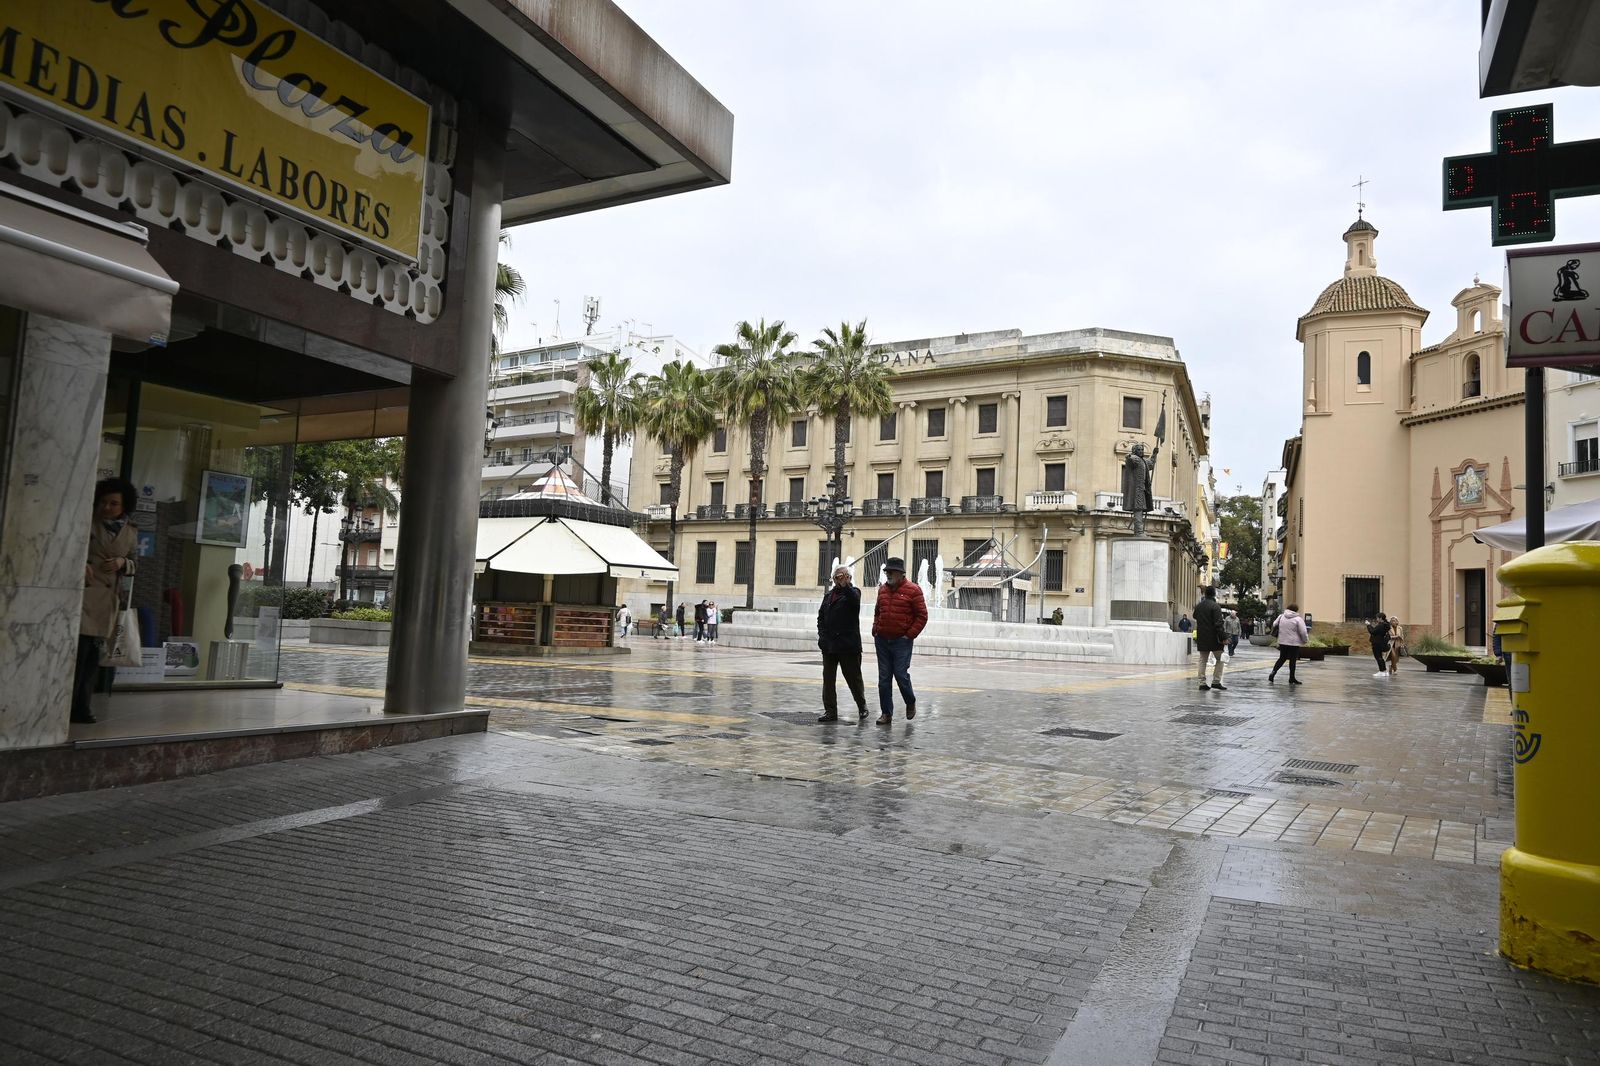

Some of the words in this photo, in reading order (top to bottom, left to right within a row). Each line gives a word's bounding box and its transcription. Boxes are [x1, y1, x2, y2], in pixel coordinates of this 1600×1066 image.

[158, 0, 416, 164] Plaza
[219, 129, 391, 240] LABORES
[1519, 307, 1600, 346] CA
